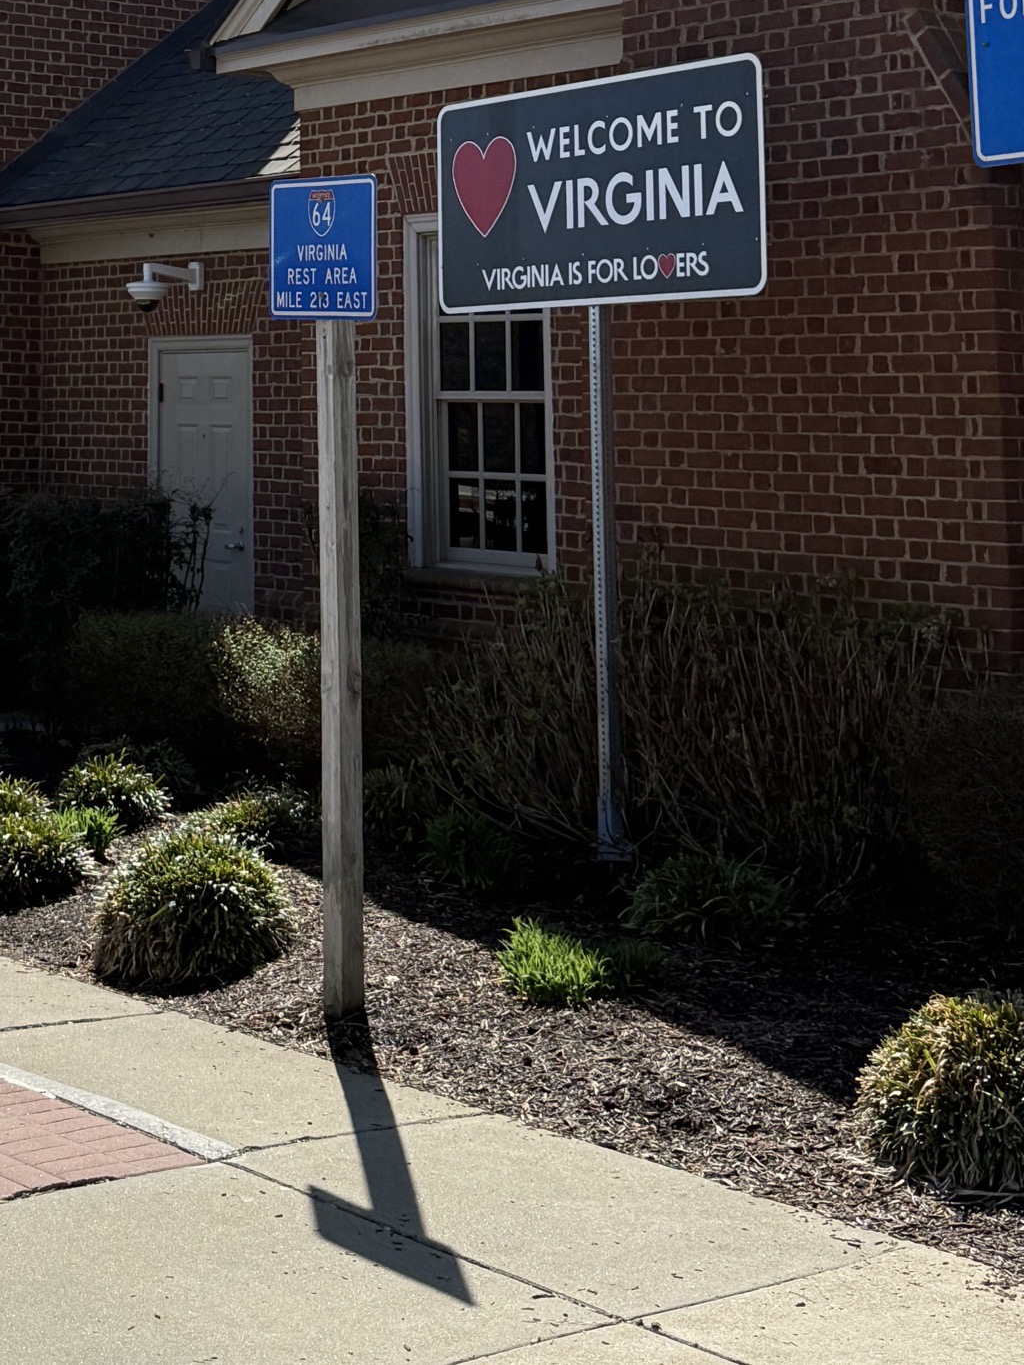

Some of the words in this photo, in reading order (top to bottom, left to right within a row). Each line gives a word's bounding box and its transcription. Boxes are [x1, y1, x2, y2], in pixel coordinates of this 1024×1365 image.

[526, 109, 679, 162] WELCOME
[693, 100, 743, 139] TO
[527, 160, 744, 233] VIRGINIA
[312, 201, 331, 226] 64
[297, 243, 348, 262] VIRGINIA
[287, 267, 317, 285] REST
[324, 266, 358, 285] AREA
[482, 263, 565, 291] VIRGINIA
[568, 261, 582, 285] IS
[587, 257, 628, 284] FOR
[276, 291, 303, 308] MILE
[337, 291, 368, 309] EAST
